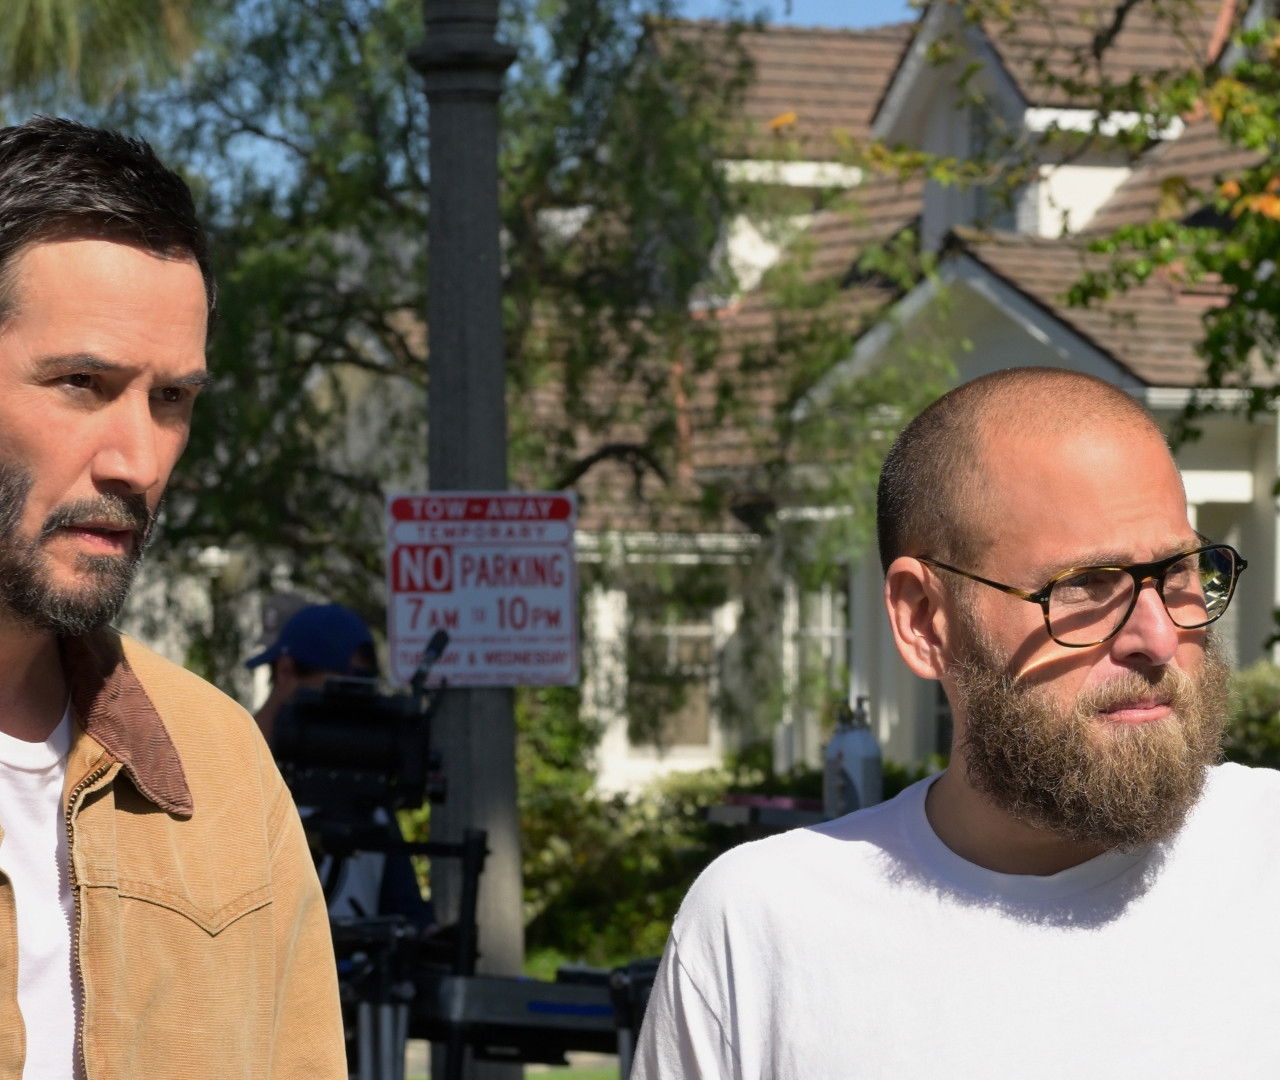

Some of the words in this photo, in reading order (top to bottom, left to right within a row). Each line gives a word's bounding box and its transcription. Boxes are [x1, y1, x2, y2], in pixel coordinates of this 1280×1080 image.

[412, 499, 554, 520] TOW-AWAY
[418, 527, 546, 537] TEMPORARY
[399, 548, 451, 590] NO
[461, 553, 564, 588] PARKING
[484, 650, 568, 664] WEDNESDAY
